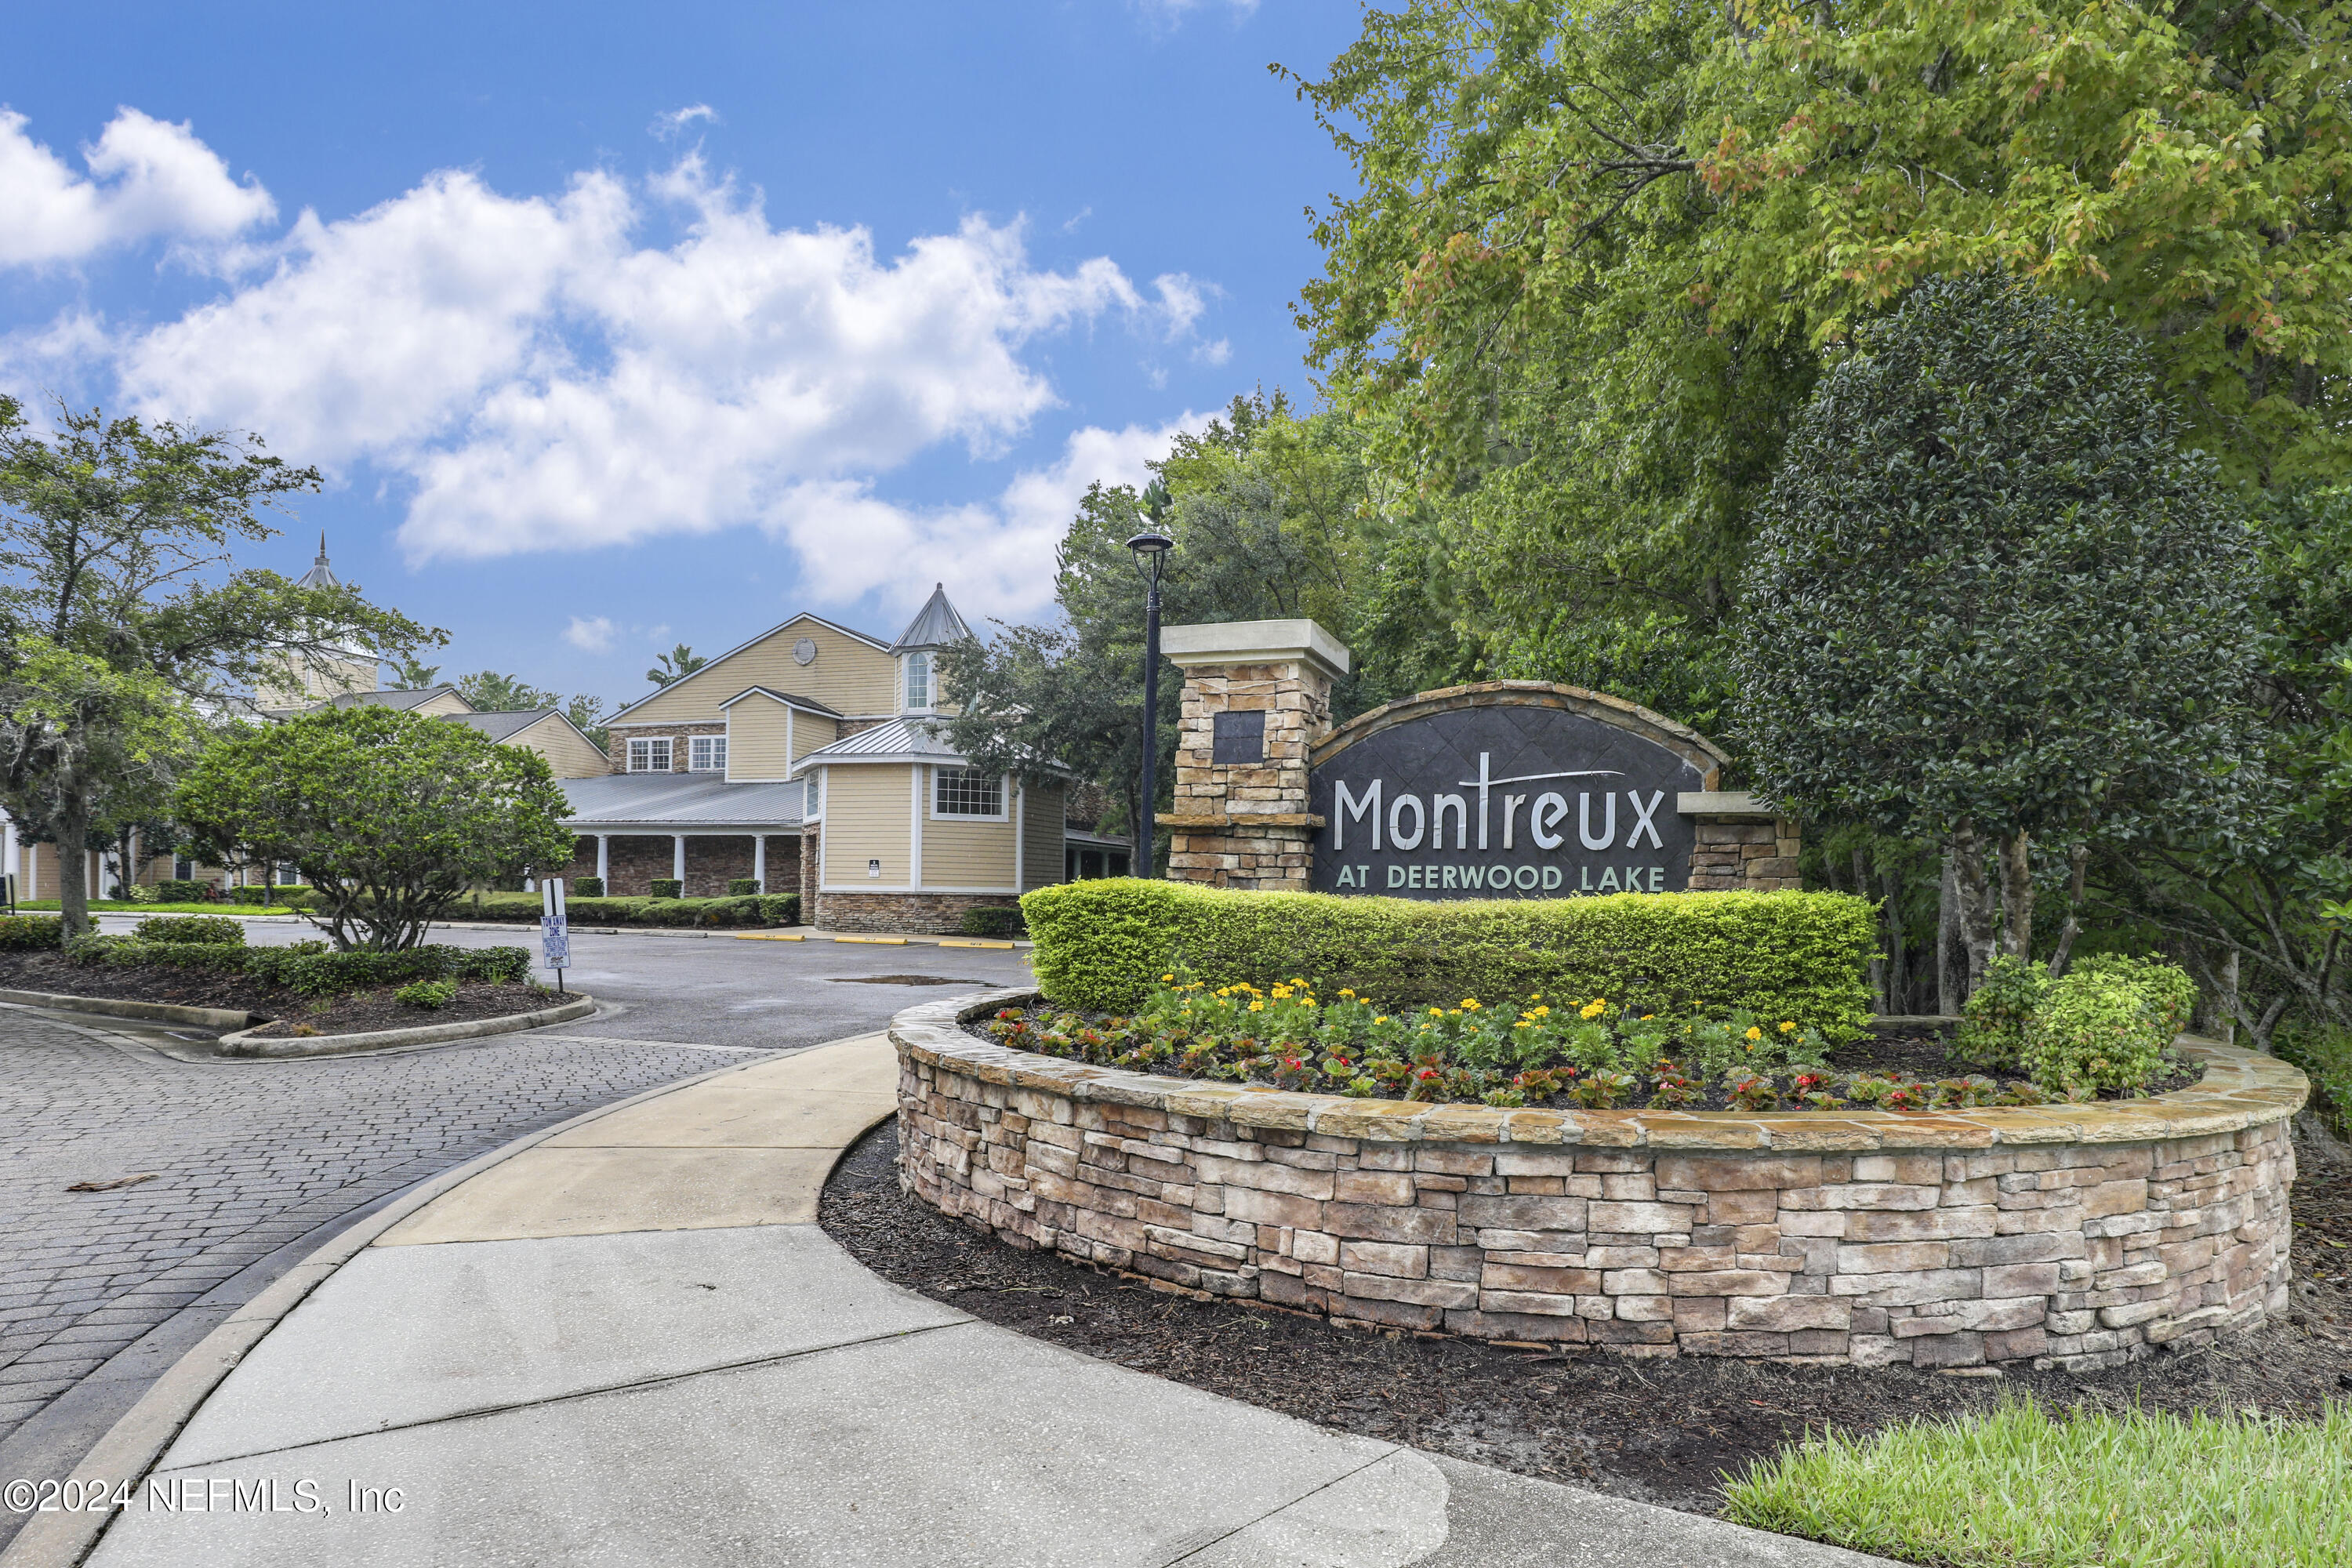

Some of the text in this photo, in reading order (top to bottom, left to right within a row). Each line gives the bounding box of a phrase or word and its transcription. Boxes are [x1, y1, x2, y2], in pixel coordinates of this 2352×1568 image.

[1334, 751, 1665, 851] Montreux
[1335, 864, 1665, 892] AT DEERWOOD LAKE
[543, 916, 564, 927] TOW AWAY
[549, 927, 560, 937] ZONE
